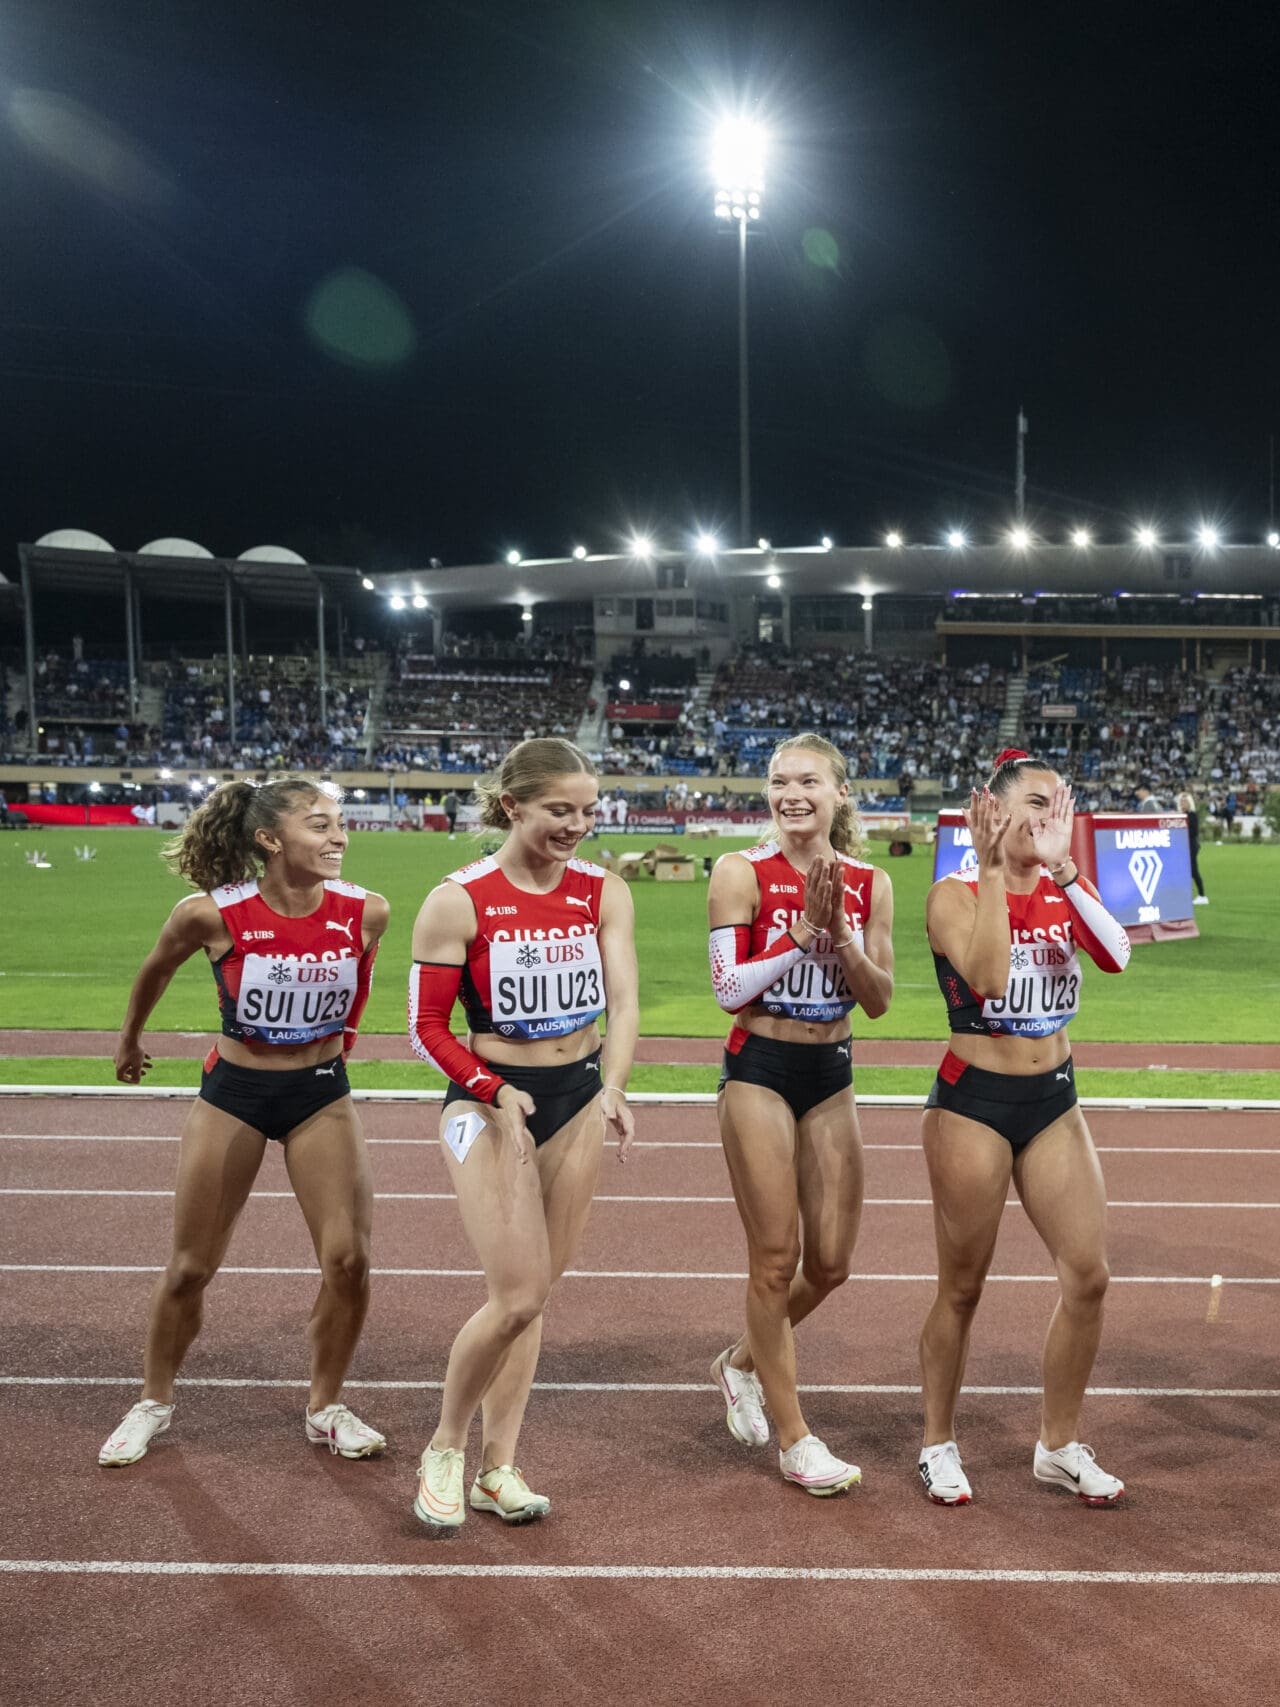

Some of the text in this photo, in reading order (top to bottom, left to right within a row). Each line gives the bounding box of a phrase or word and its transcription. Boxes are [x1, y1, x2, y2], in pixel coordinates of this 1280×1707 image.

[780, 884, 798, 894] UBS
[496, 905, 518, 915] UBS
[254, 930, 275, 940] UBS
[545, 942, 584, 964] UBS
[1031, 948, 1066, 966] UBS
[296, 966, 340, 983] UBS
[821, 963, 853, 999] U2
[498, 968, 600, 1015] SUI U23
[1041, 974, 1078, 1013] U23
[243, 988, 350, 1023] SUI U23
[792, 1006, 844, 1017] LAUSANNE
[528, 1016, 586, 1033] LAUSANNE
[1012, 1019, 1063, 1032] LAUSANNE
[268, 1027, 326, 1040] LAUSANNE
[456, 1120, 467, 1144] 7
